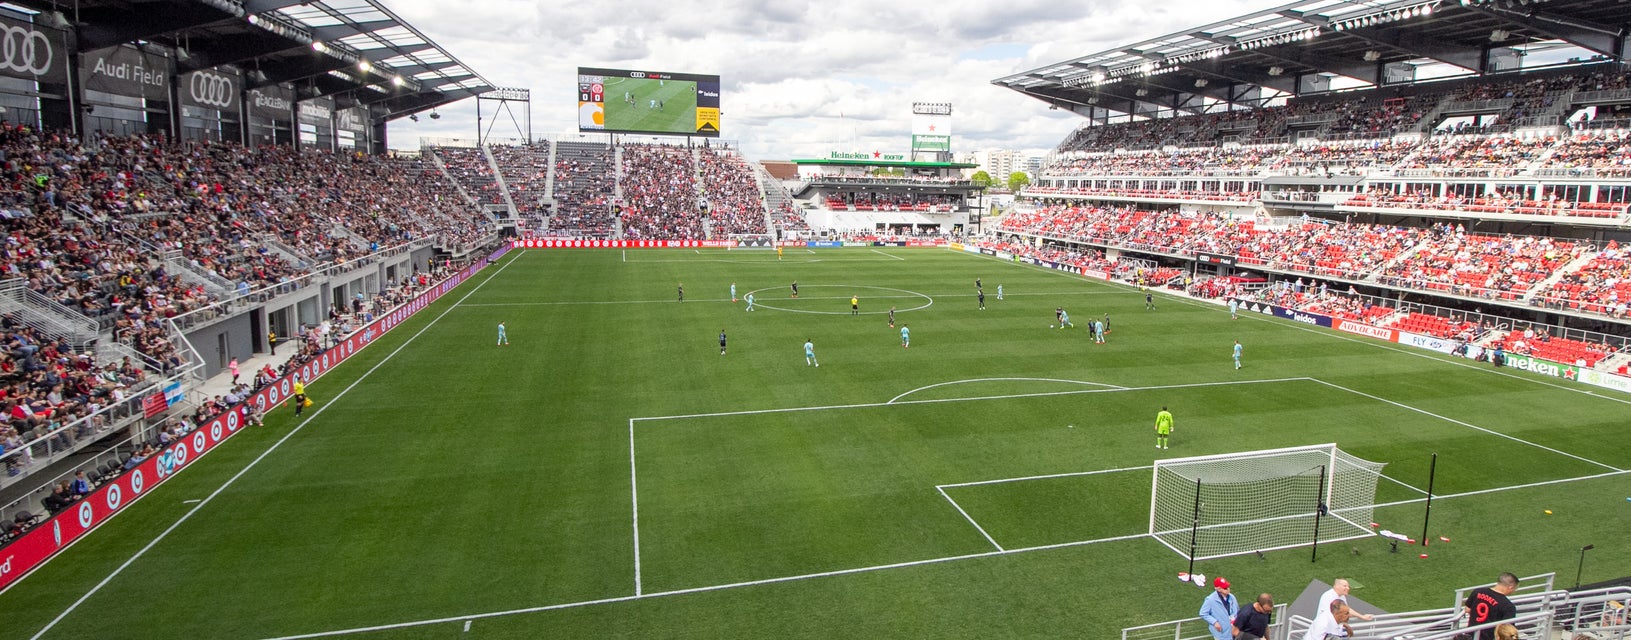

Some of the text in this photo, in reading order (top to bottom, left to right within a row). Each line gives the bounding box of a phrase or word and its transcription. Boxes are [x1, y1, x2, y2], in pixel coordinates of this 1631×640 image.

[93, 57, 163, 86] Audi Field
[831, 151, 869, 160] Heineken
[1294, 312, 1317, 325] leidos
[1340, 321, 1390, 339] ADVOCARE
[1413, 336, 1426, 346] FLY
[1603, 375, 1628, 388] Lime
[1476, 602, 1489, 623] 9
